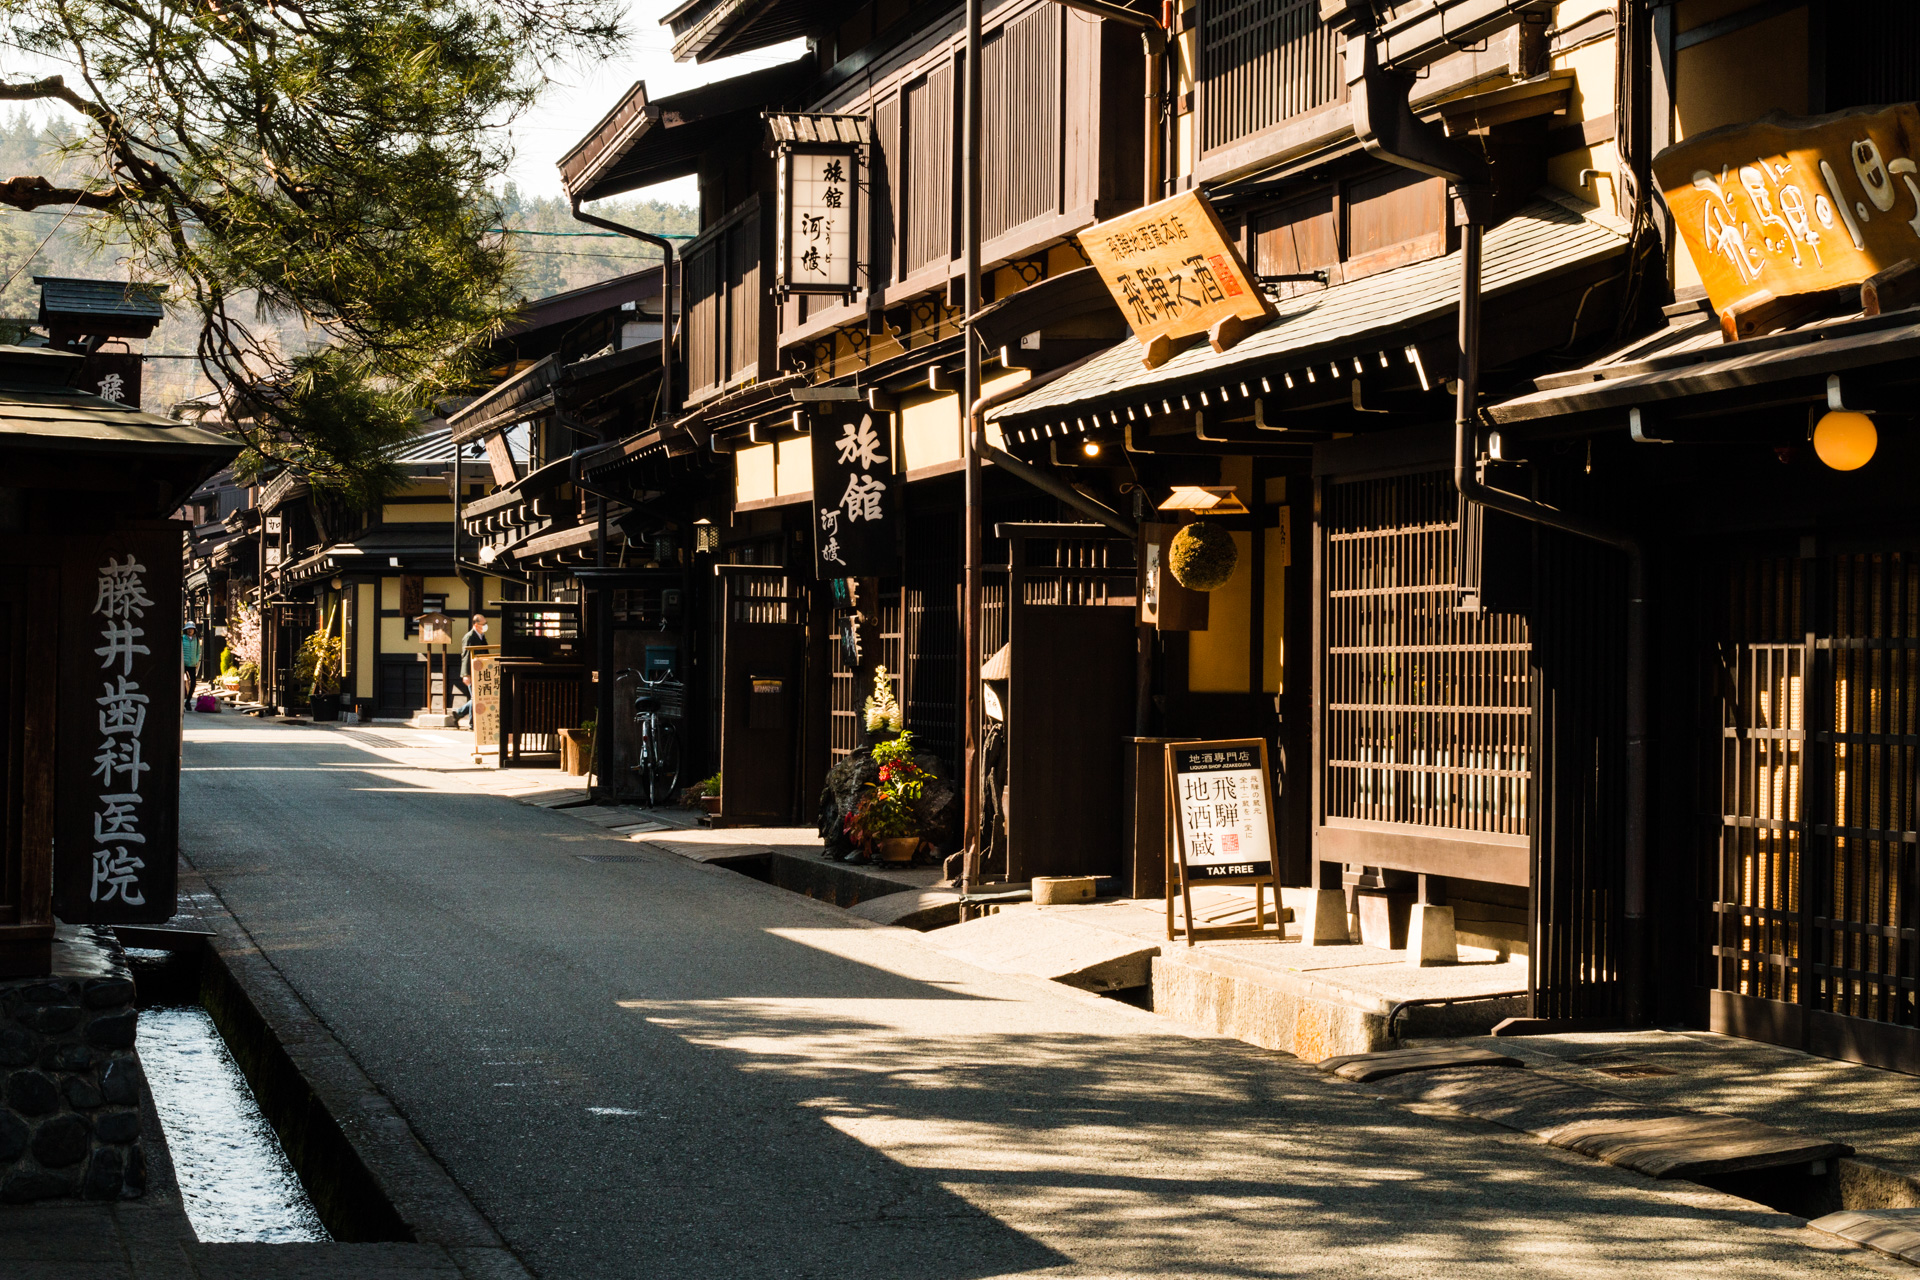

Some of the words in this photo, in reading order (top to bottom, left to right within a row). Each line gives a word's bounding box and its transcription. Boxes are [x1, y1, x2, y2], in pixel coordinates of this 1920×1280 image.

[822, 158, 847, 210] 旅館
[825, 219, 836, 264] ごうど
[1117, 253, 1226, 326] 飛騨之酒
[834, 413, 889, 523] 旅館
[478, 668, 492, 697] 地酒
[90, 553, 155, 906] 藤井歯科医院
[1222, 761, 1252, 769] JIZAKEGURA
[1184, 777, 1215, 857] 地酒蔵
[1212, 776, 1240, 828] 飛騨
[1206, 866, 1227, 876] TAX
[1228, 864, 1255, 875] FREE
